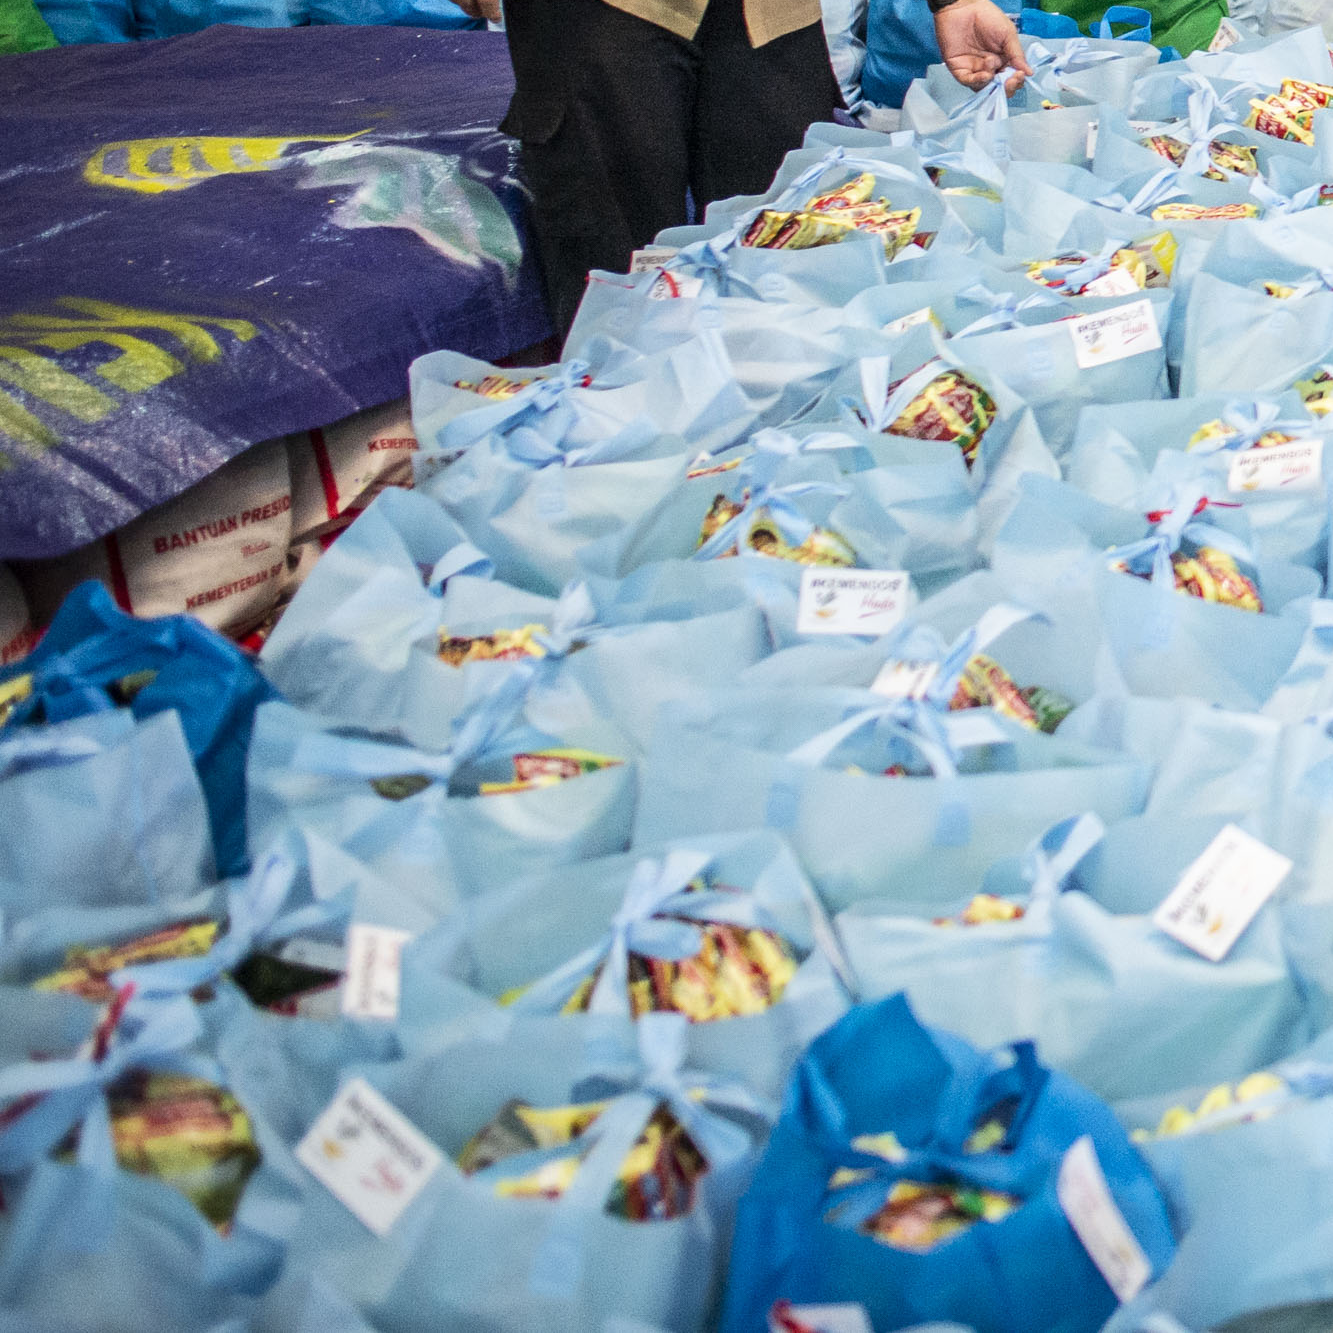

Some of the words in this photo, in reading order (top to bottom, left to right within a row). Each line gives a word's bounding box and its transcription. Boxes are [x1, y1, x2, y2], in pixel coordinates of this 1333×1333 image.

[368, 438, 419, 452] KEMENTER
[154, 517, 238, 555] BANTUAN
[242, 495, 291, 529] PRESID
[186, 572, 268, 611] KEMENTERIAN
